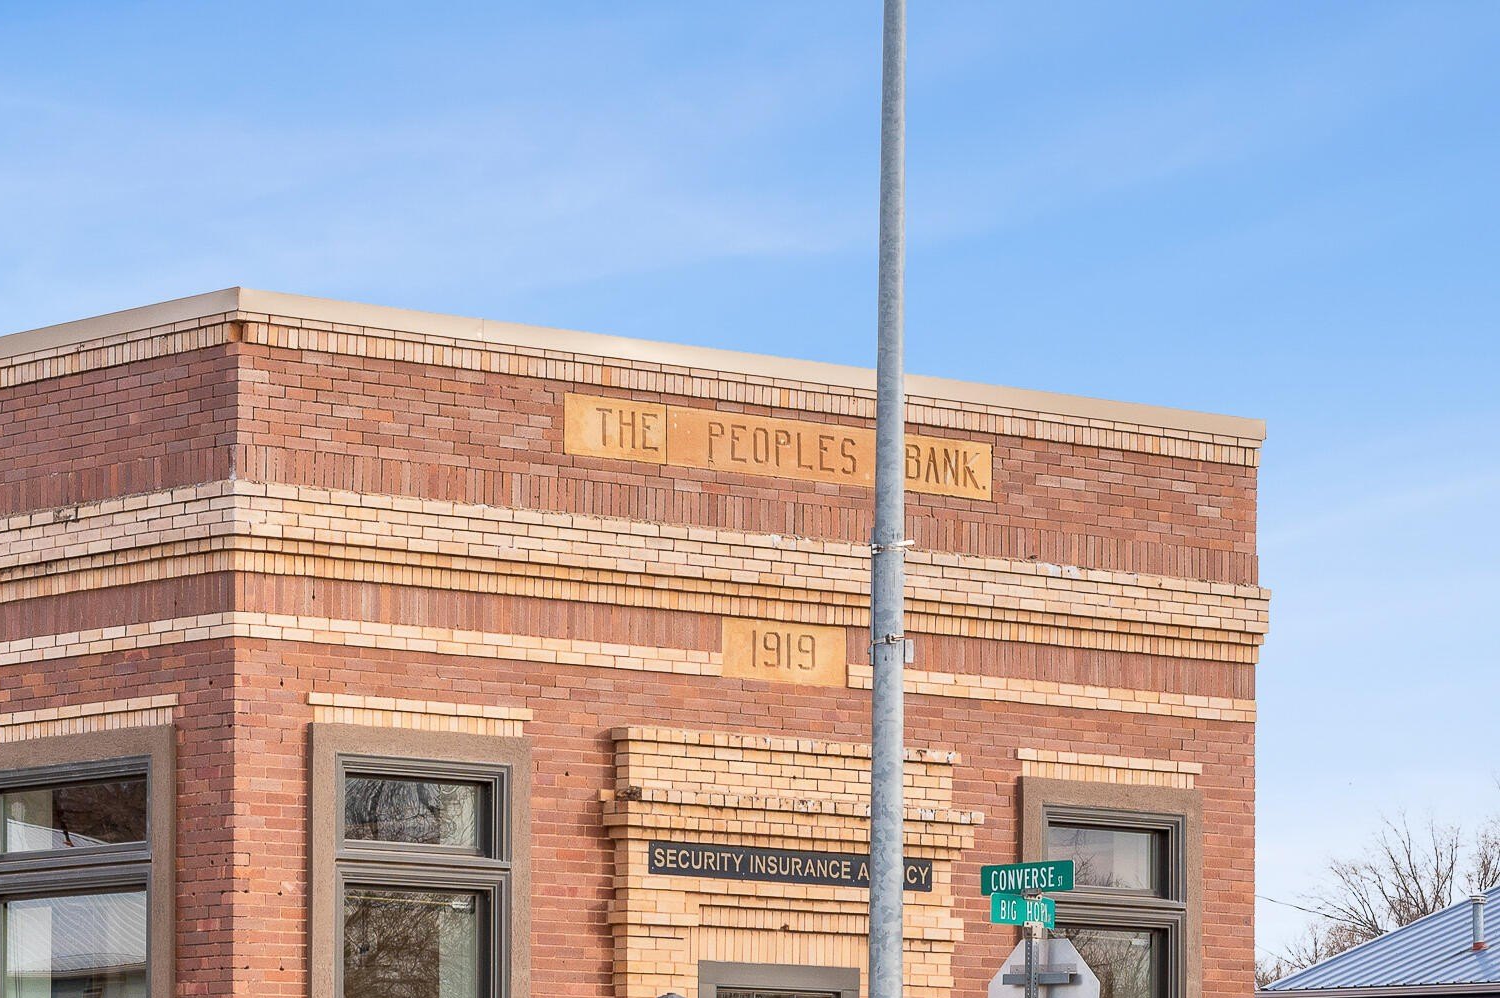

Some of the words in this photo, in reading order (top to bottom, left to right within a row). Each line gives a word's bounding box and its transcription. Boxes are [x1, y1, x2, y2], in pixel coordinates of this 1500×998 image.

[595, 406, 659, 453] THE
[708, 420, 857, 475] PEOPLES
[750, 629, 816, 671] 1919
[654, 848, 743, 872] SECURITY
[749, 855, 852, 880] INSURANCE
[857, 862, 929, 885] ACY
[991, 866, 1055, 892] CONVERSE
[1057, 875, 1063, 887] ST
[1000, 899, 1017, 921] BIG
